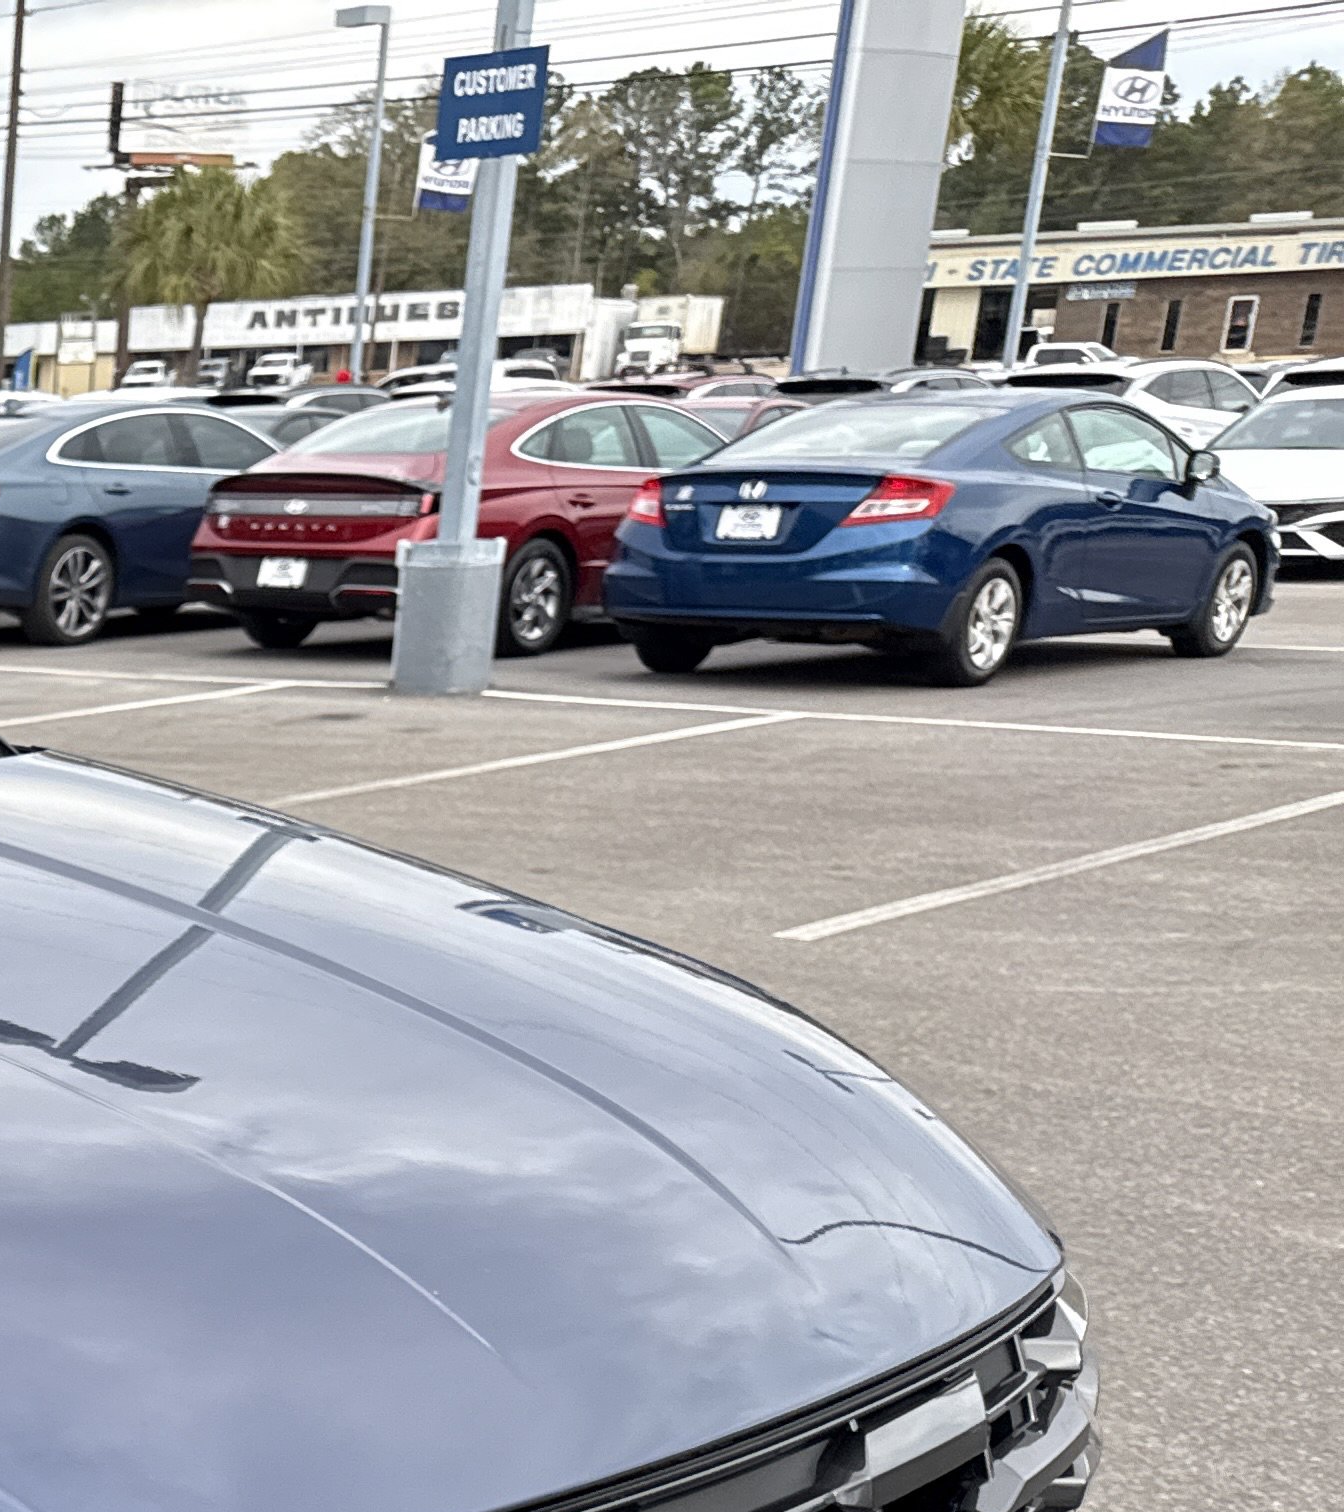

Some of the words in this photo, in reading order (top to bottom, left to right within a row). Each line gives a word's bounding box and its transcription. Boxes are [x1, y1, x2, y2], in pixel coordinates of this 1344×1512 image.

[453, 64, 537, 97] CUSTOMER
[456, 112, 525, 143] PARKING
[1072, 245, 1277, 276] COMMERCIAL
